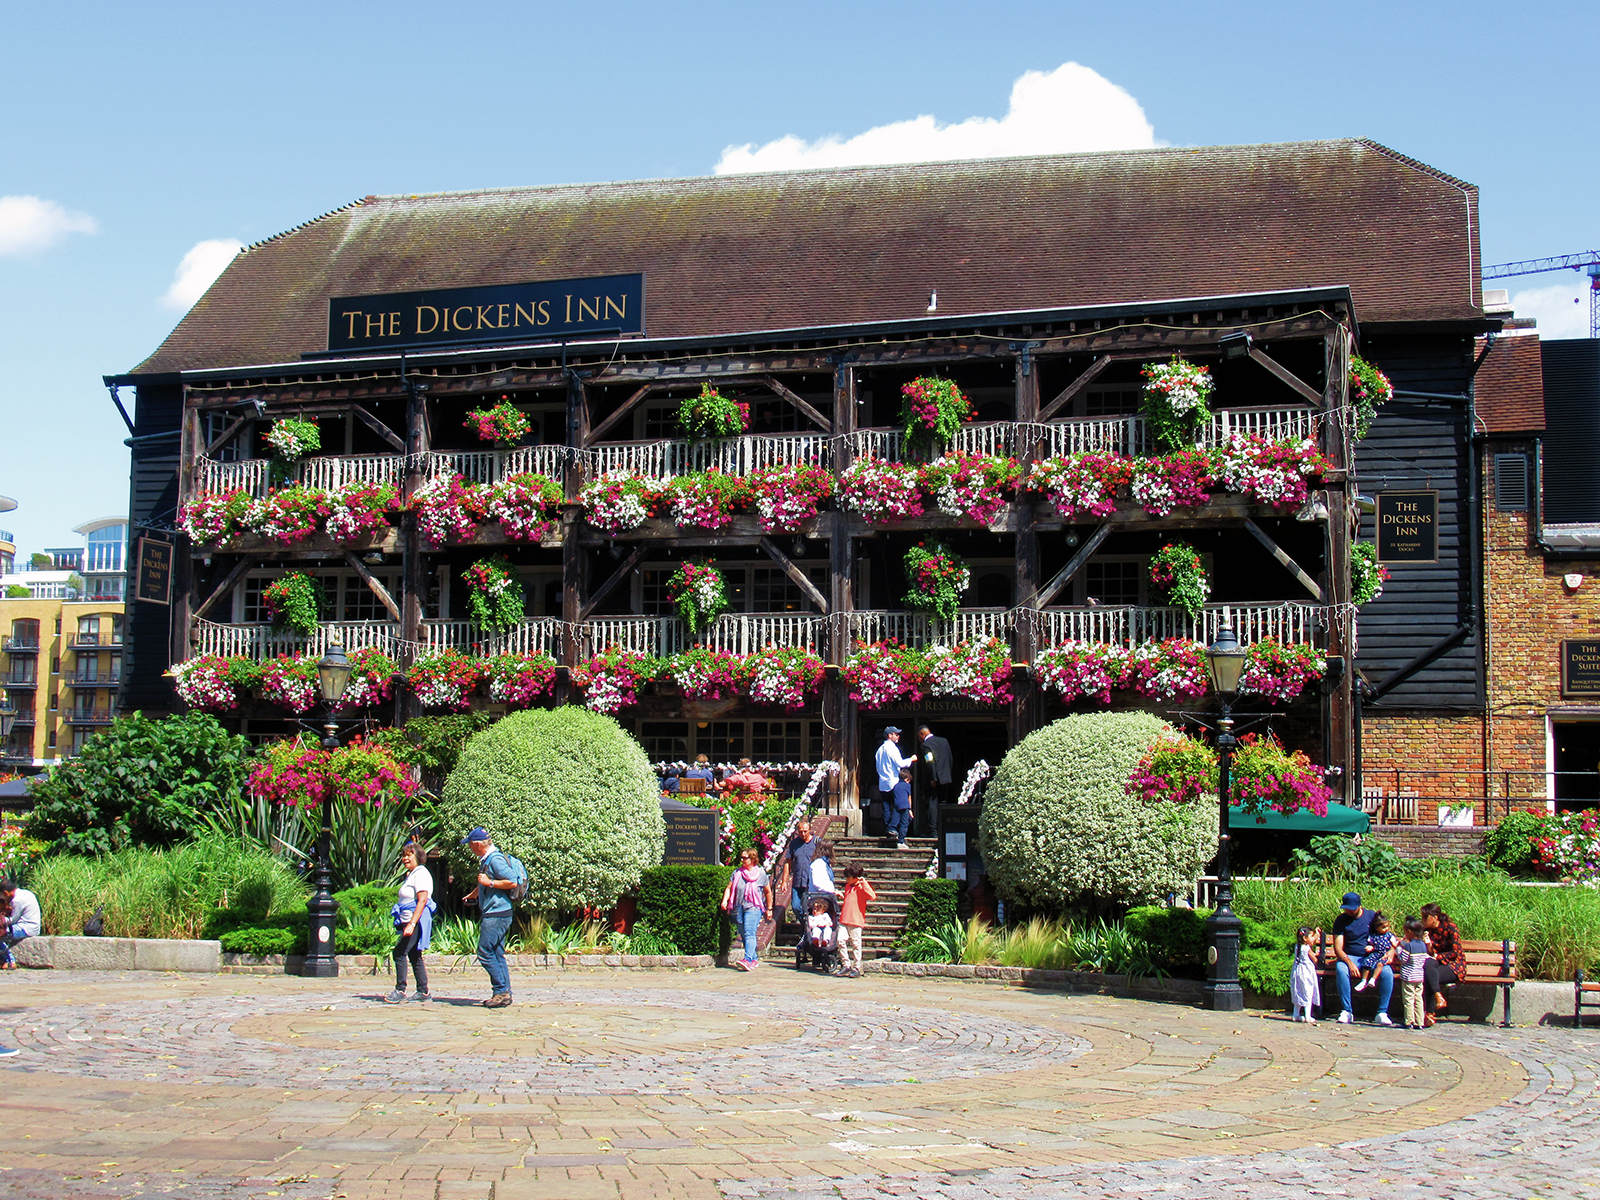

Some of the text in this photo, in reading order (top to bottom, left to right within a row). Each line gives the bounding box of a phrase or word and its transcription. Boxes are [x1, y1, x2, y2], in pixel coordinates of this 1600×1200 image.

[342, 294, 627, 338] THE DICKENS INN
[1395, 502, 1418, 511] THE
[1383, 514, 1431, 524] DICKENS
[1396, 526, 1418, 535] INN
[151, 549, 162, 559] THE
[143, 558, 168, 570] DICKENS
[149, 570, 161, 579] INN
[1581, 645, 1597, 653] THE
[879, 702, 894, 710] AR
[896, 702, 920, 711] AND
